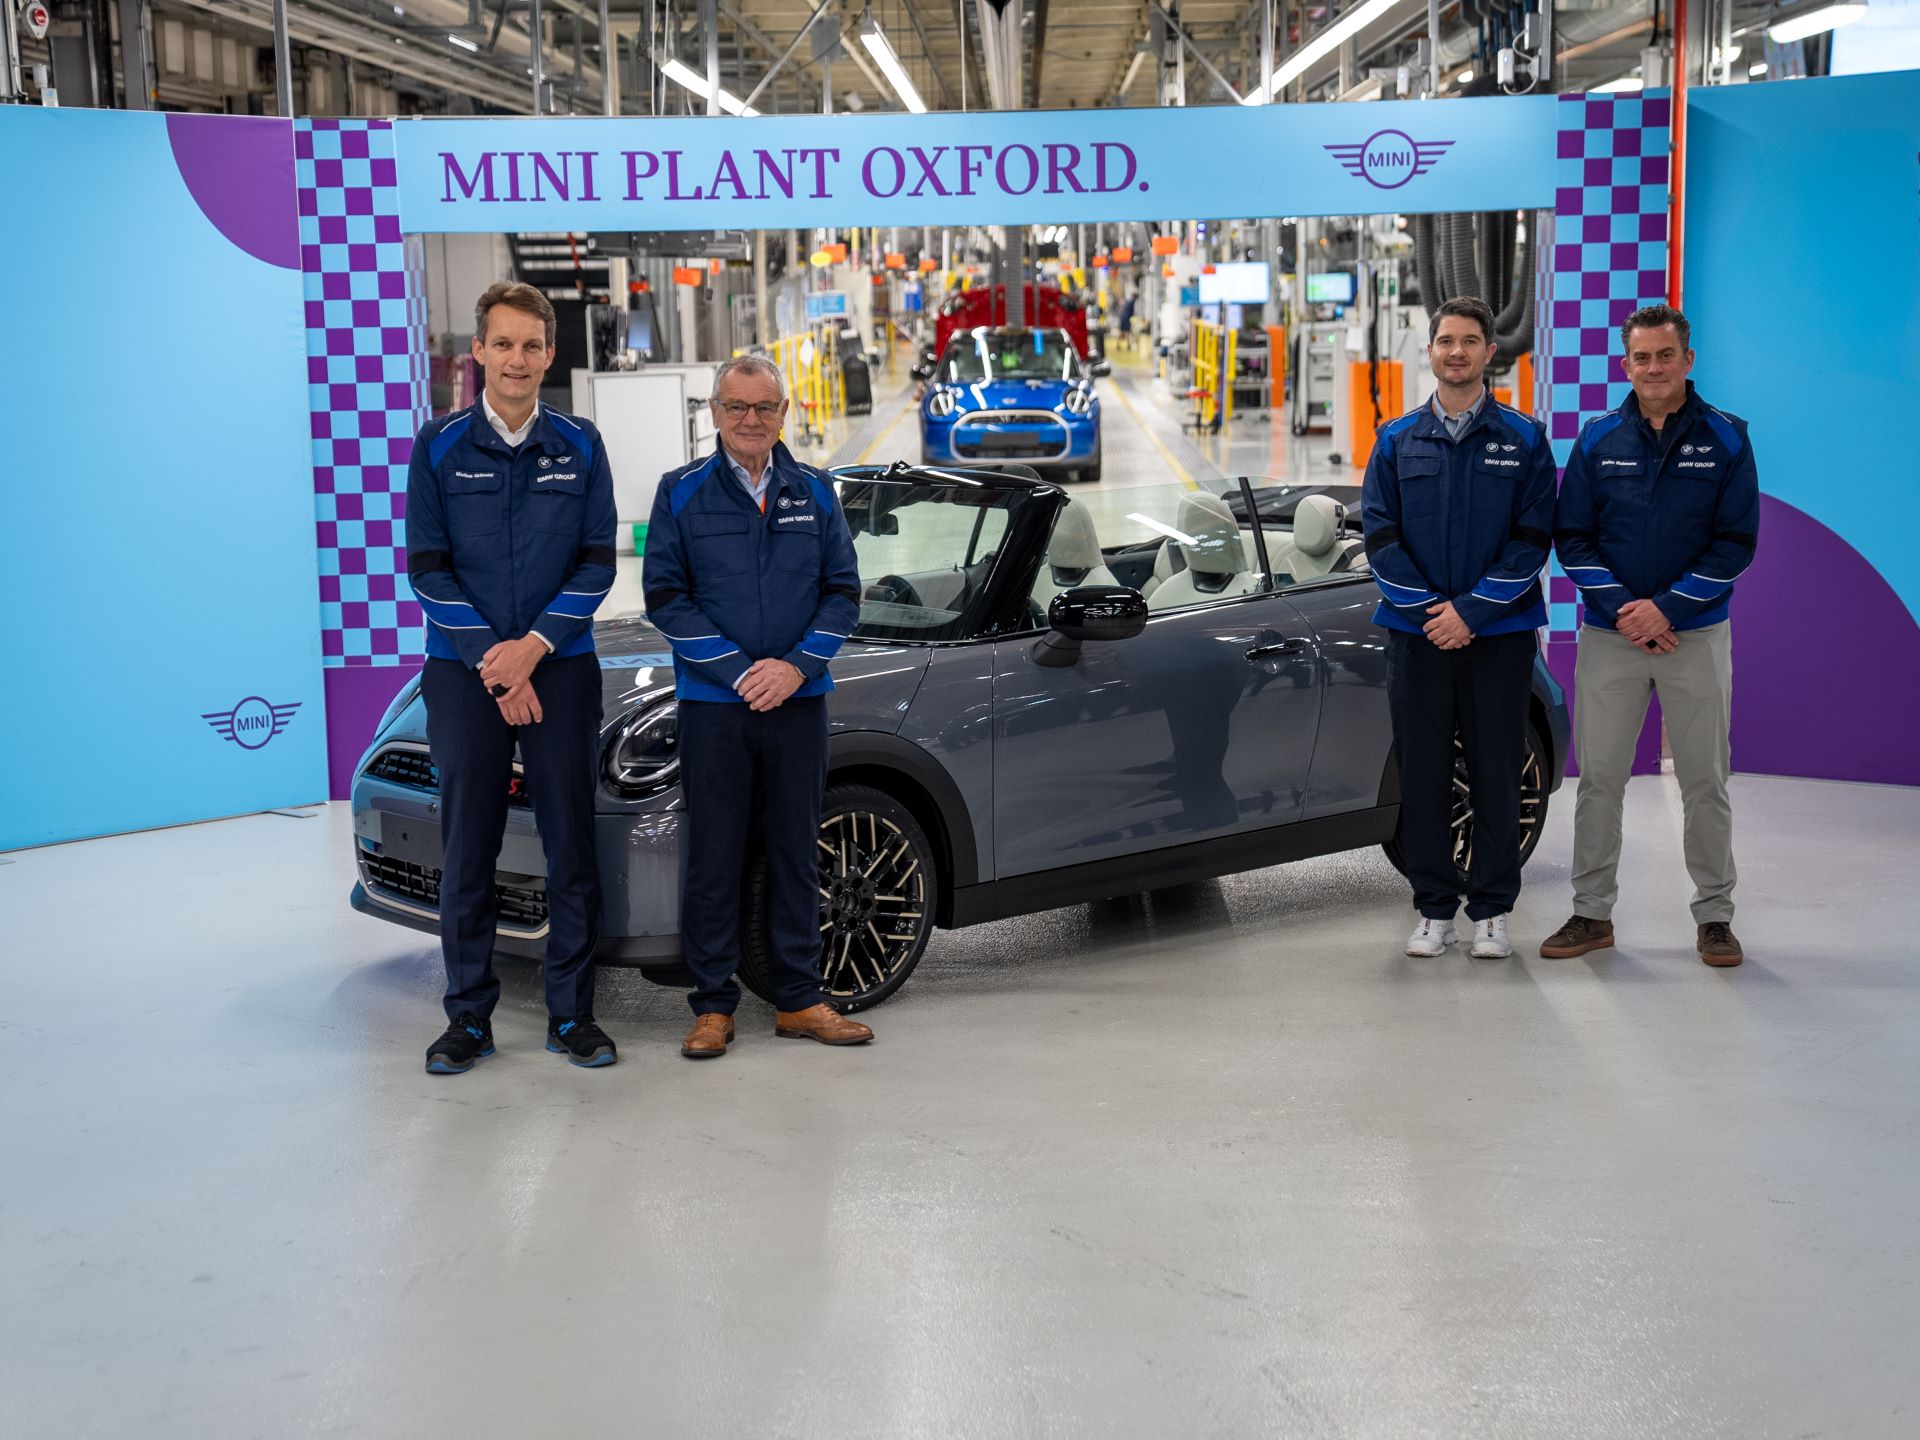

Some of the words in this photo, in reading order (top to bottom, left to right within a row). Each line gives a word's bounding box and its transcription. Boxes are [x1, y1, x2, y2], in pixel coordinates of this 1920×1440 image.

[1368, 151, 1410, 167] MINI
[437, 151, 601, 203] MINI
[619, 148, 840, 201] PLANT
[861, 141, 1150, 199] OXFORD.
[537, 474, 554, 482] BMW
[236, 714, 270, 732] MINI
